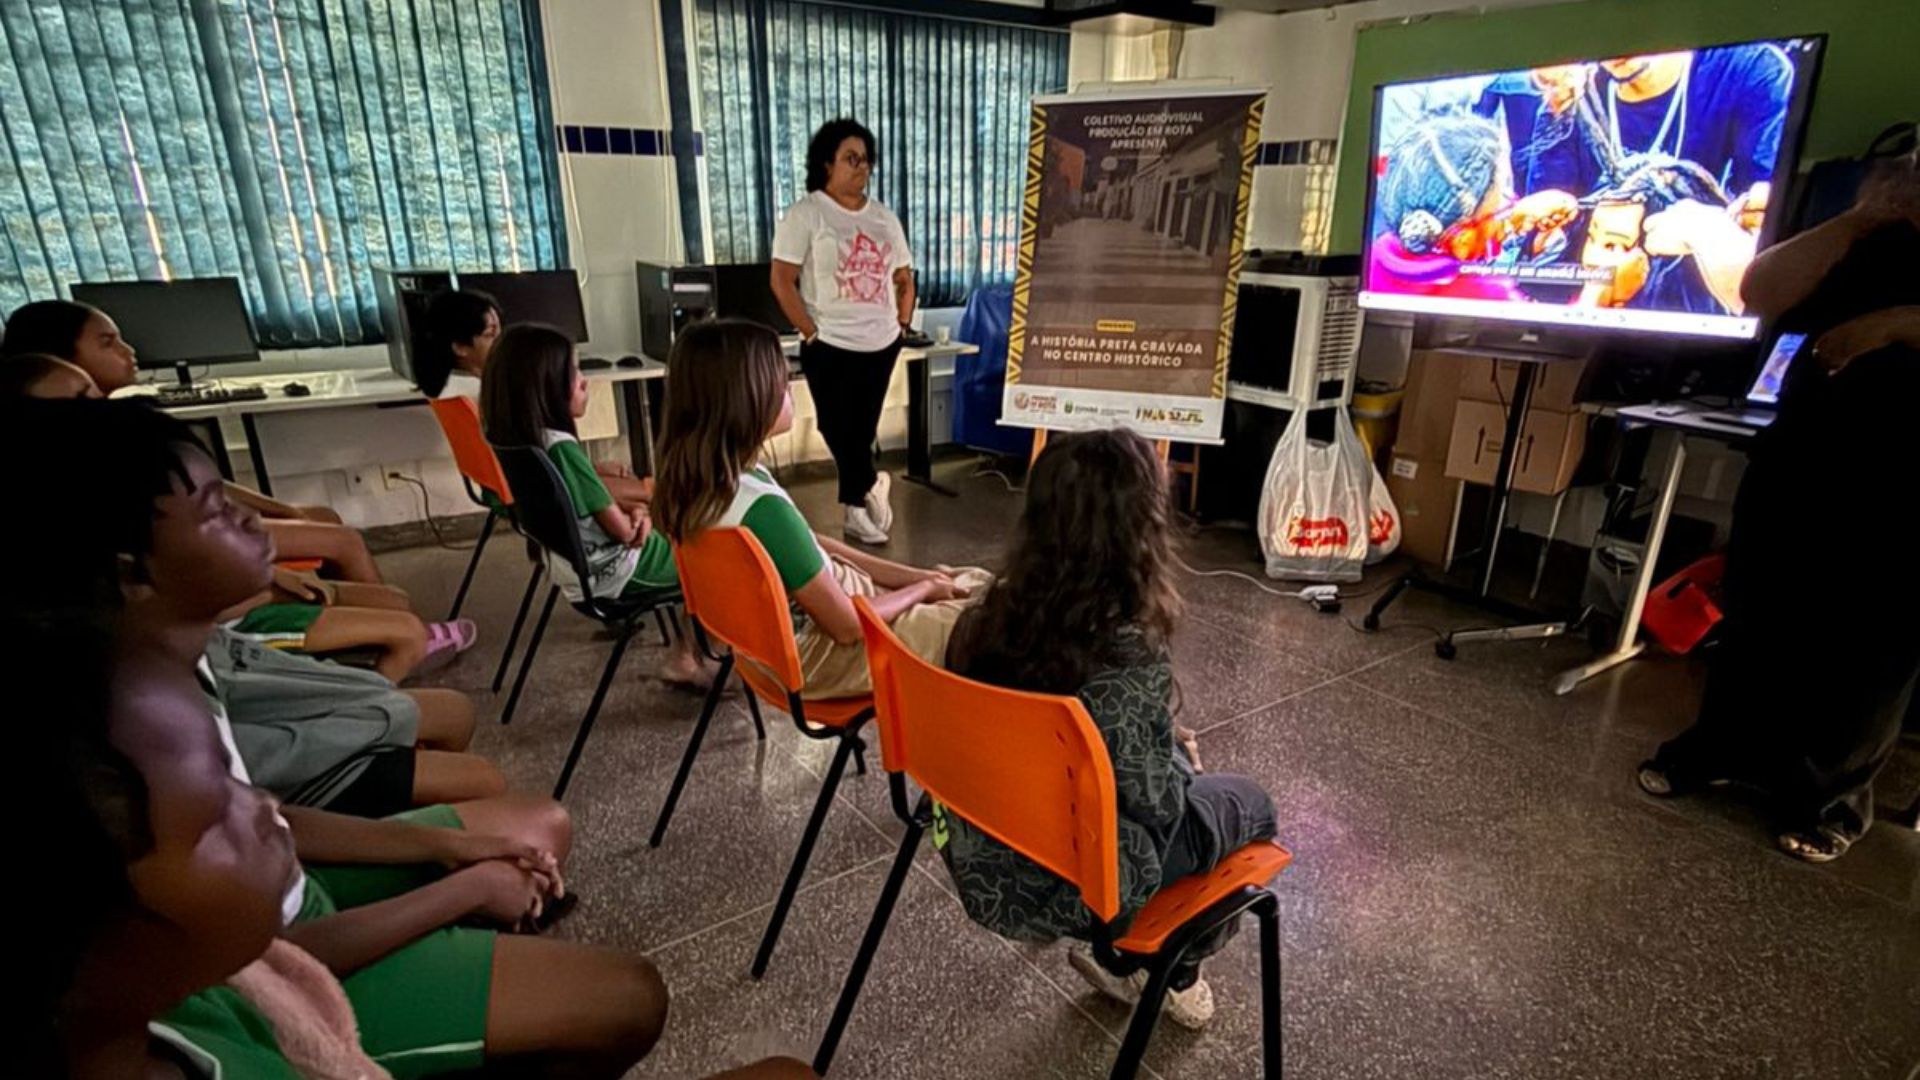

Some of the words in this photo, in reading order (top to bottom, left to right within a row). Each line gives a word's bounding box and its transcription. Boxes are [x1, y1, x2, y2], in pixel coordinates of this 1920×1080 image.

[1083, 114, 1133, 126] COLETIVO
[1134, 112, 1203, 124] AUDIOVISUAL
[1088, 125, 1145, 138] PRODUÇÃO
[1146, 125, 1163, 136] EM
[1164, 125, 1193, 136] ROTA
[1110, 138, 1168, 150] APRESENTA
[1030, 336, 1039, 346] A
[1041, 335, 1096, 349] HISTÓRIA
[1100, 339, 1137, 351] PRETA
[1140, 340, 1203, 355] CRAVADA
[1043, 350, 1061, 360] NO
[1063, 351, 1112, 363] CENTRO
[1114, 353, 1182, 367] HISTÓRICO
